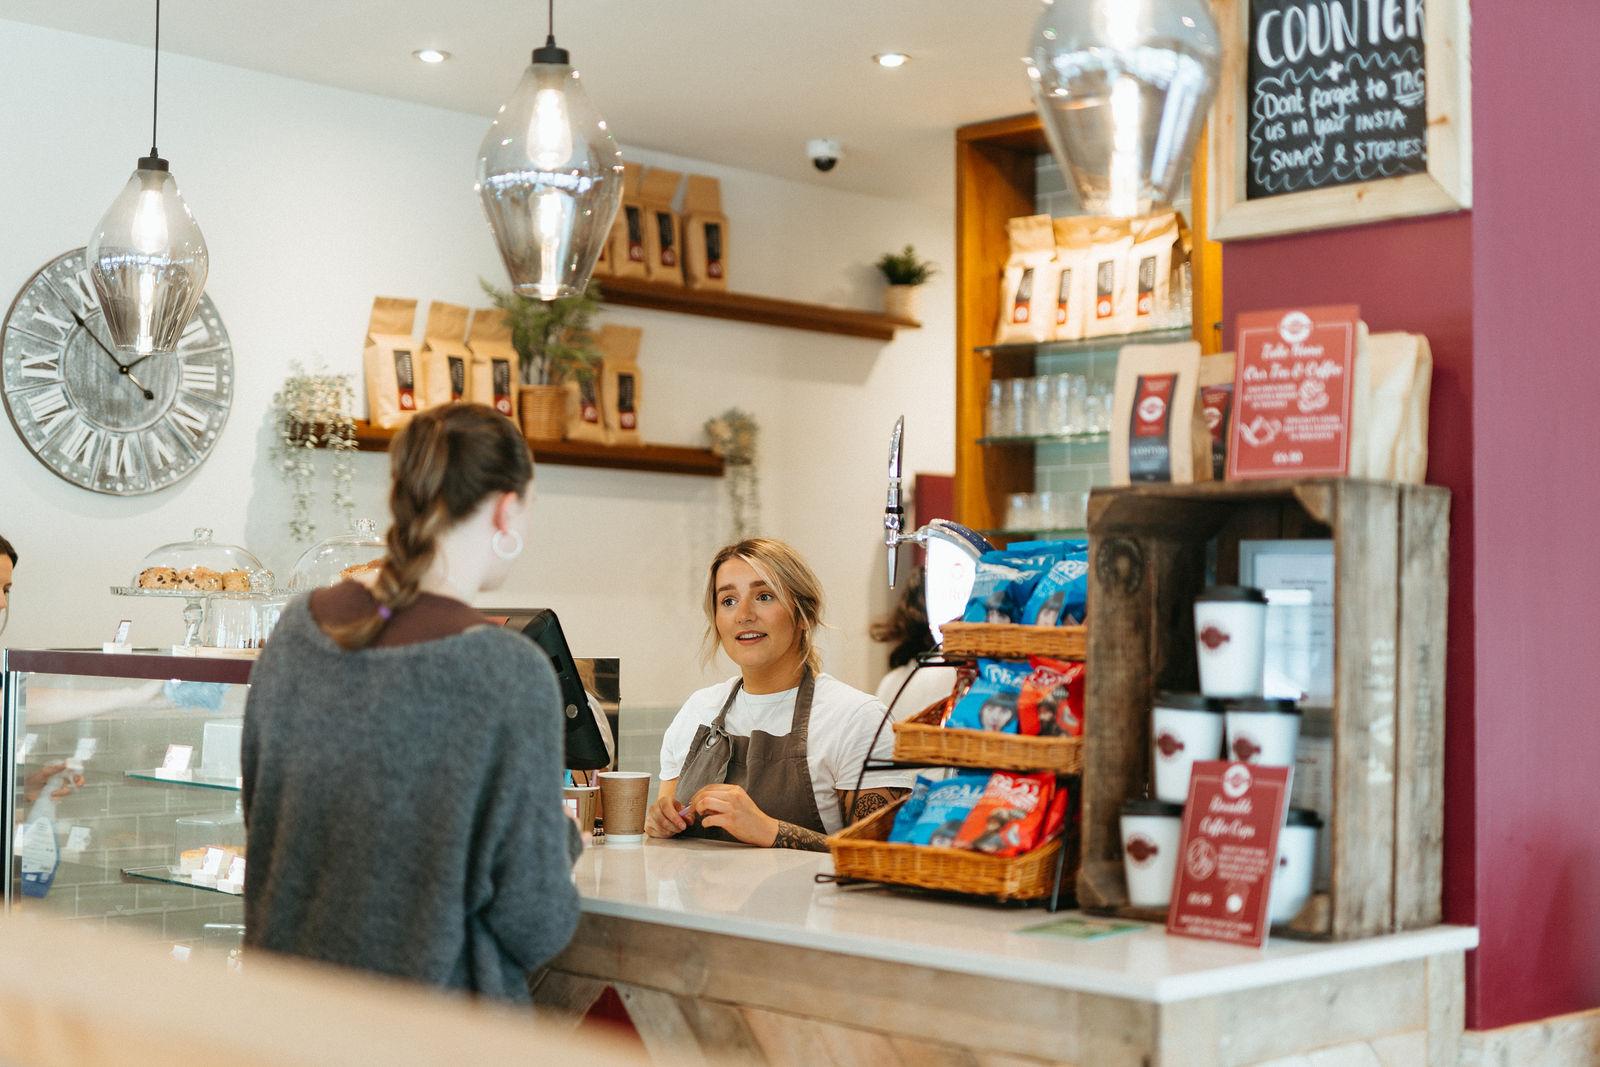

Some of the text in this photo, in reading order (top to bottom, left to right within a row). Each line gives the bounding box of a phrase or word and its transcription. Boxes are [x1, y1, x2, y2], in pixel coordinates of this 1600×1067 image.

[1257, 0, 1426, 68] COUNTER
[1310, 79, 1360, 120] forget
[1366, 77, 1388, 99] to
[1391, 68, 1425, 96] TAG
[1355, 109, 1407, 131] INSTA
[1334, 143, 1348, 165] &
